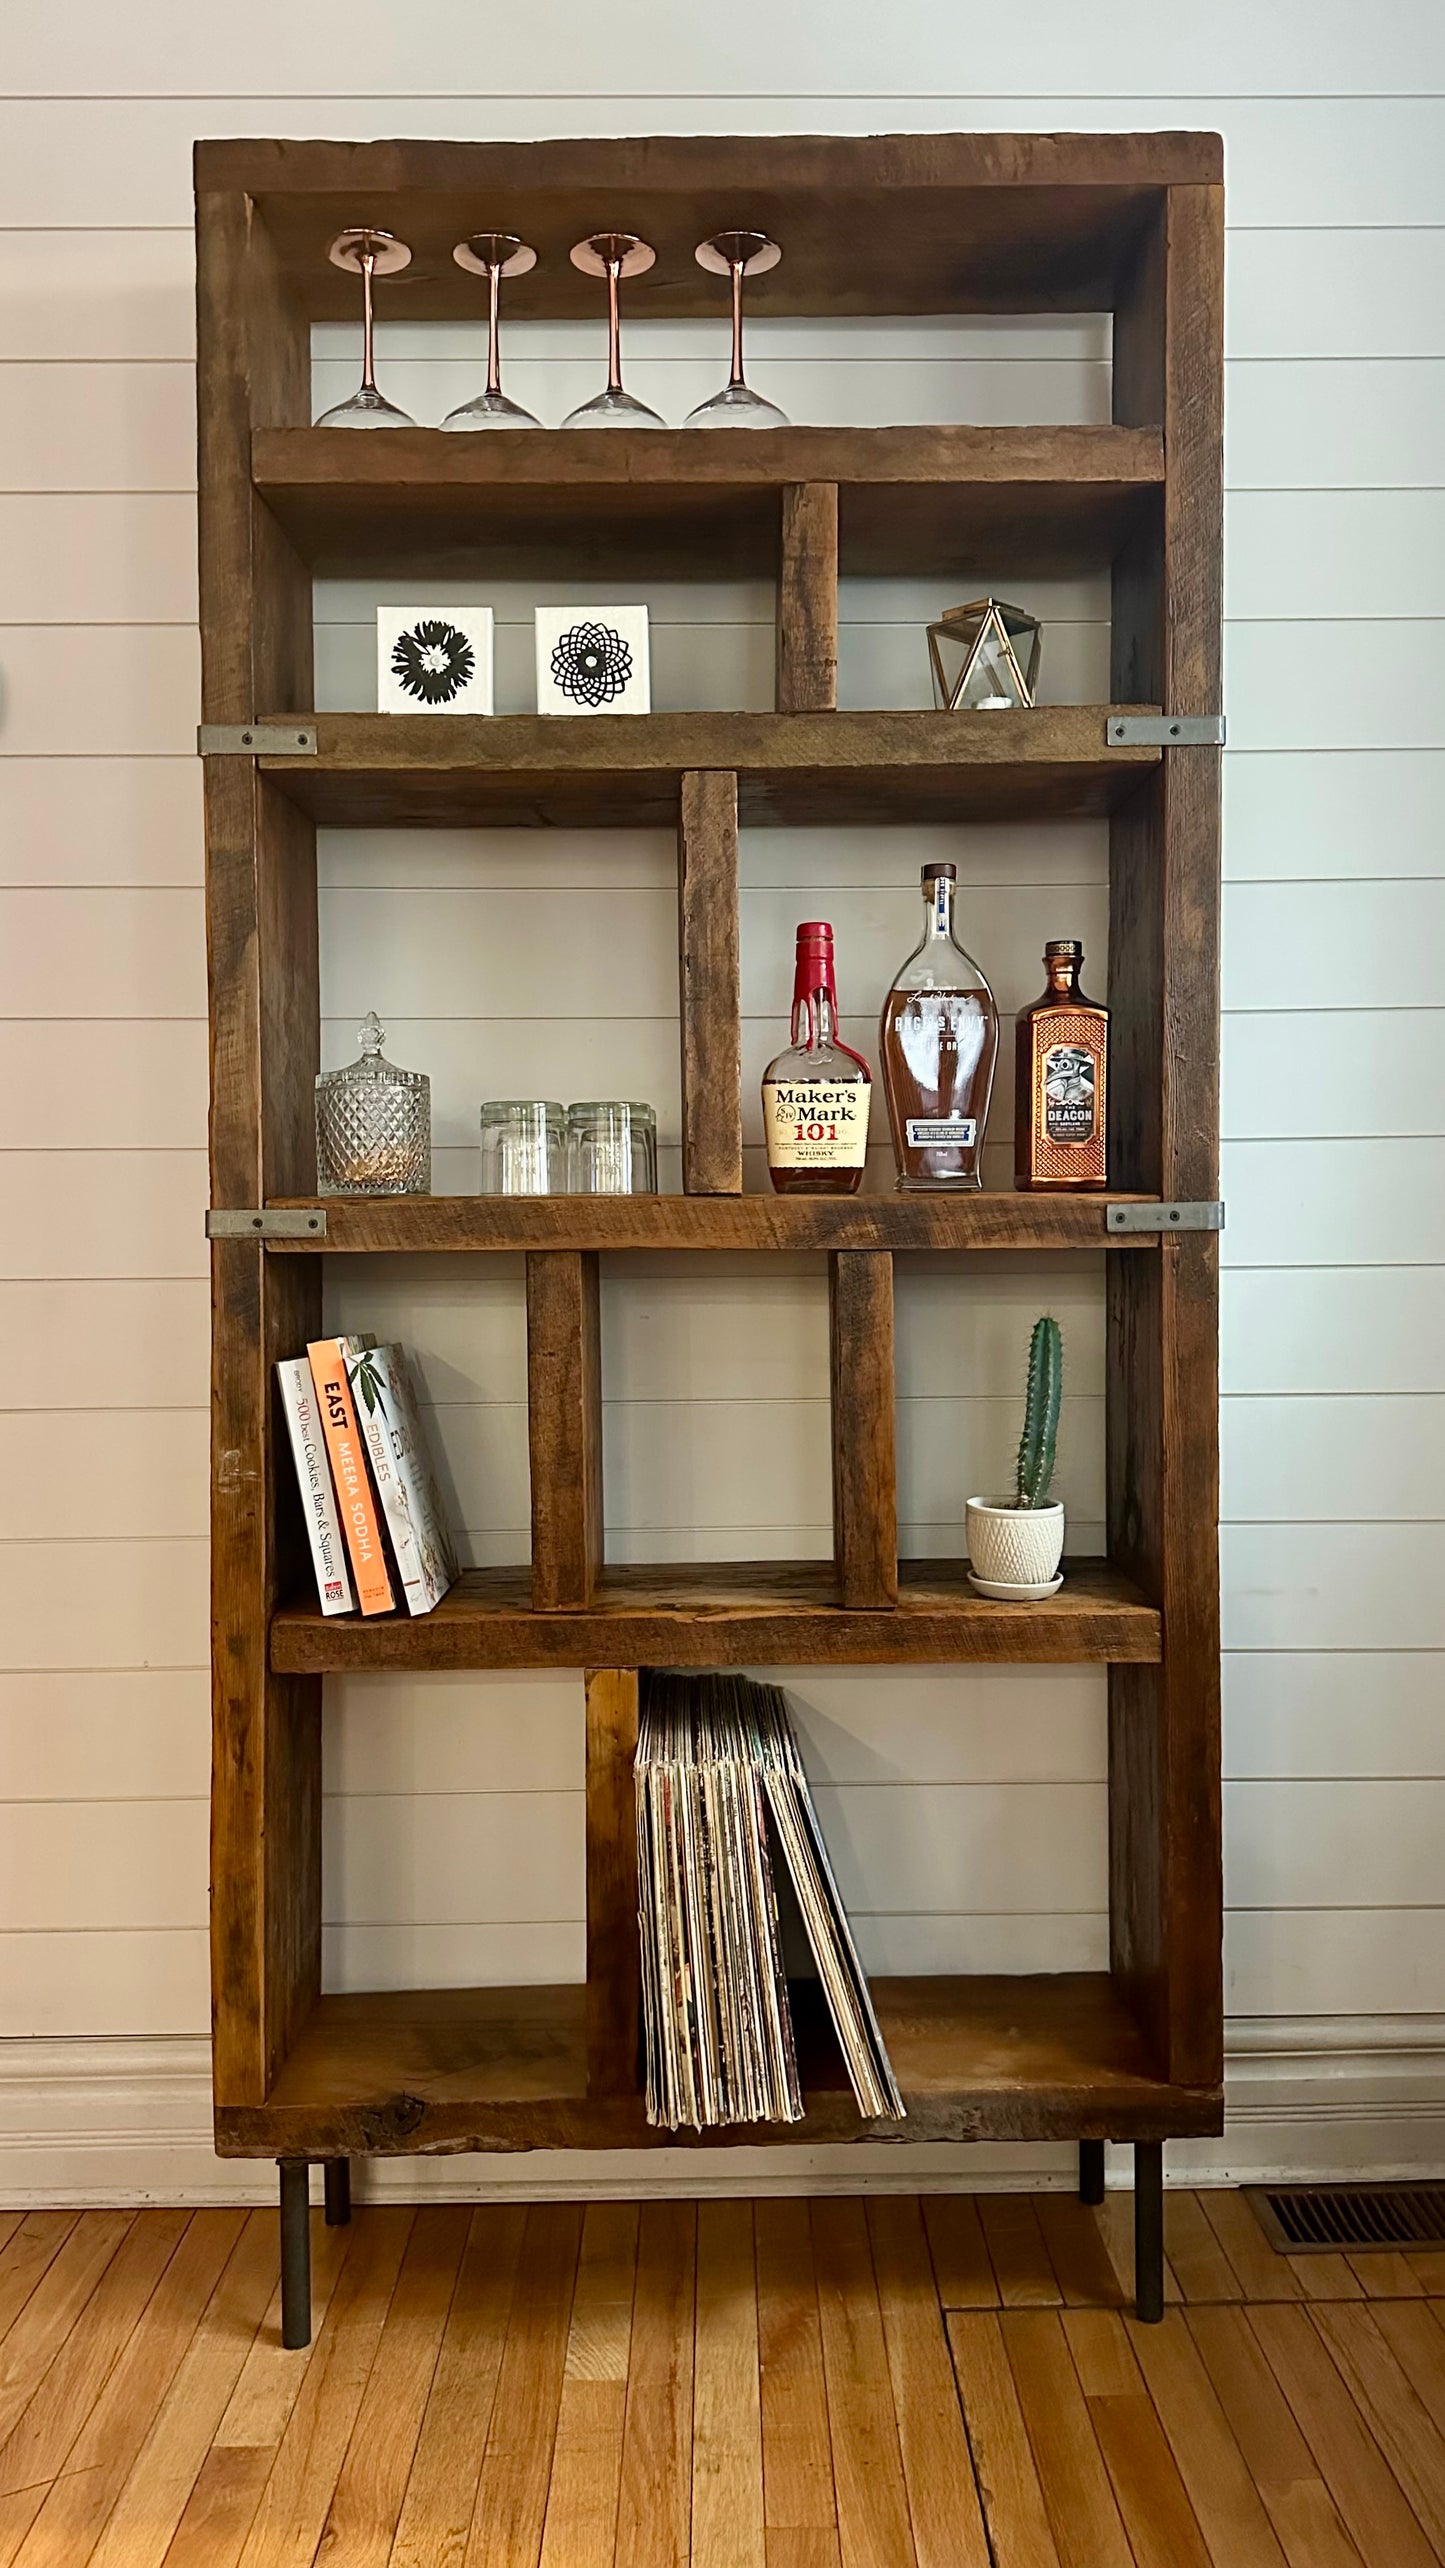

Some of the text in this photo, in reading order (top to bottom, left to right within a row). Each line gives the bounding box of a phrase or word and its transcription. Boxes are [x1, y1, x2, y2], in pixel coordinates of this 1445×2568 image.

[775, 1089, 856, 1103] Maker's
[797, 1107, 855, 1121] Mark
[1048, 1110, 1092, 1121] DEACON
[794, 1123, 838, 1141] 101
[296, 1398, 311, 1422] 500
[300, 1424, 310, 1442] best
[367, 1424, 391, 1482] EDIBLES
[304, 1443, 320, 1491] Cookies,
[324, 1382, 373, 1562] EAST MEERA SODHA
[313, 1493, 325, 1518] Bars
[318, 1520, 329, 1530] &
[319, 1532, 334, 1577] Squares
[325, 1589, 344, 1600] ROSE
